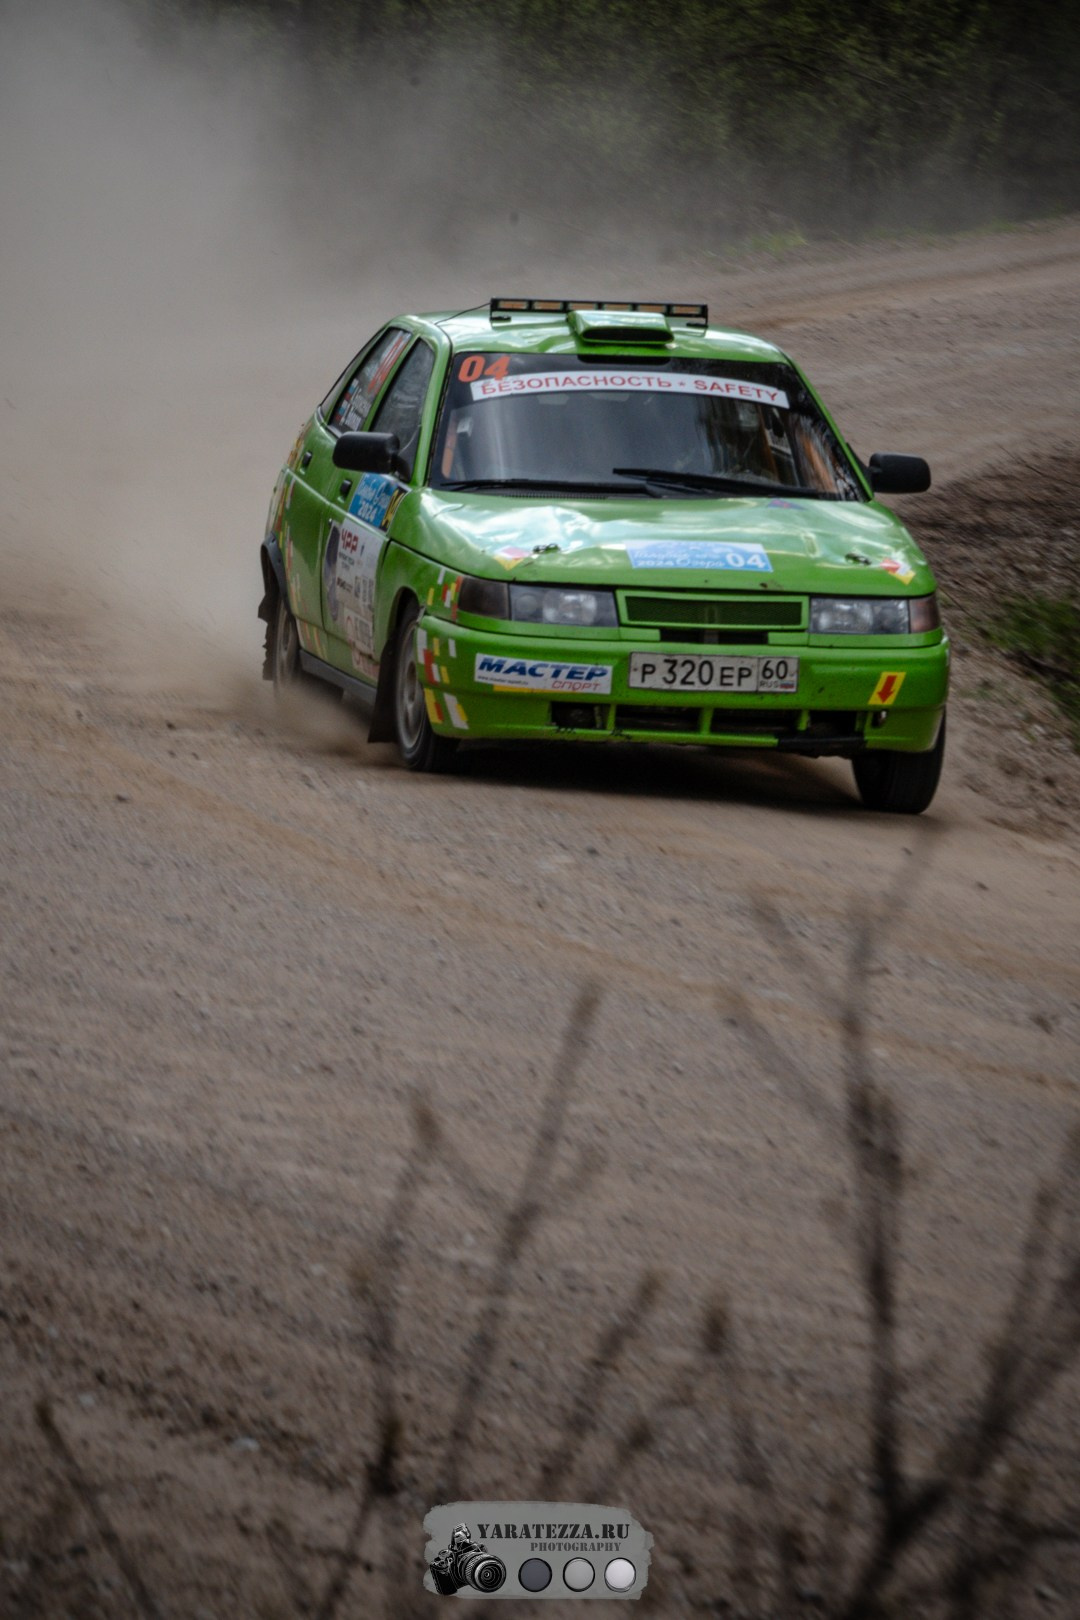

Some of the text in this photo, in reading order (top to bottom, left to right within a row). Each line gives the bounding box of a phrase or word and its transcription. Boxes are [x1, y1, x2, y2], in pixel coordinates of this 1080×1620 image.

[458, 355, 511, 383] 04
[481, 374, 778, 402] БЕЗОПАСНОСТЬ SAFETY
[725, 552, 766, 569] 04
[478, 657, 608, 681] МАСТЕР
[762, 660, 788, 680] 60
[551, 680, 601, 692] СПОРТ
[760, 680, 780, 689] RUS
